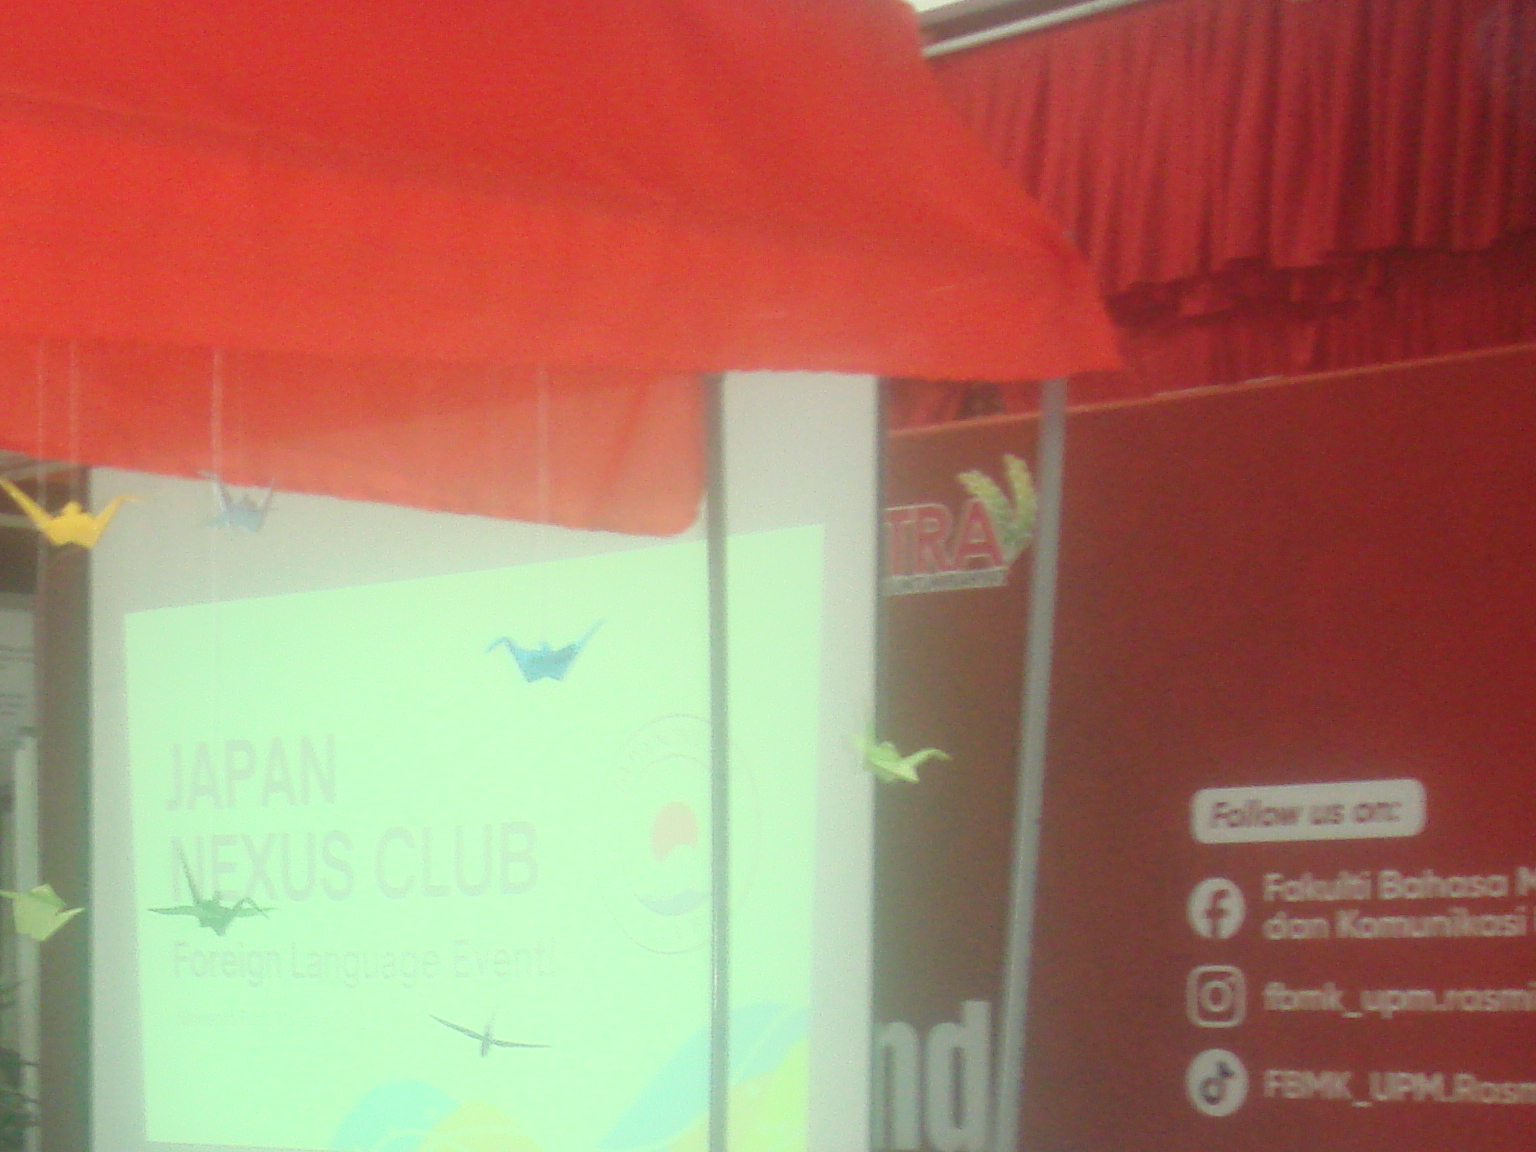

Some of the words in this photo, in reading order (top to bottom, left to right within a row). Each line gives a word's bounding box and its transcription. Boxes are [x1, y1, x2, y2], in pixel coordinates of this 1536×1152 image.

[166, 733, 336, 810] JAPAN
[1209, 800, 1304, 828] Follow
[1311, 804, 1345, 825] us
[1352, 801, 1403, 823] on:
[170, 829, 355, 902] NEXUS
[374, 821, 539, 899] CLUB
[1264, 871, 1371, 901] Fakulti
[1378, 869, 1509, 899] Bahasa
[1264, 911, 1330, 940] dan
[1335, 905, 1527, 938] Komunikasi
[174, 941, 282, 987] Foreign
[291, 940, 440, 989] Language
